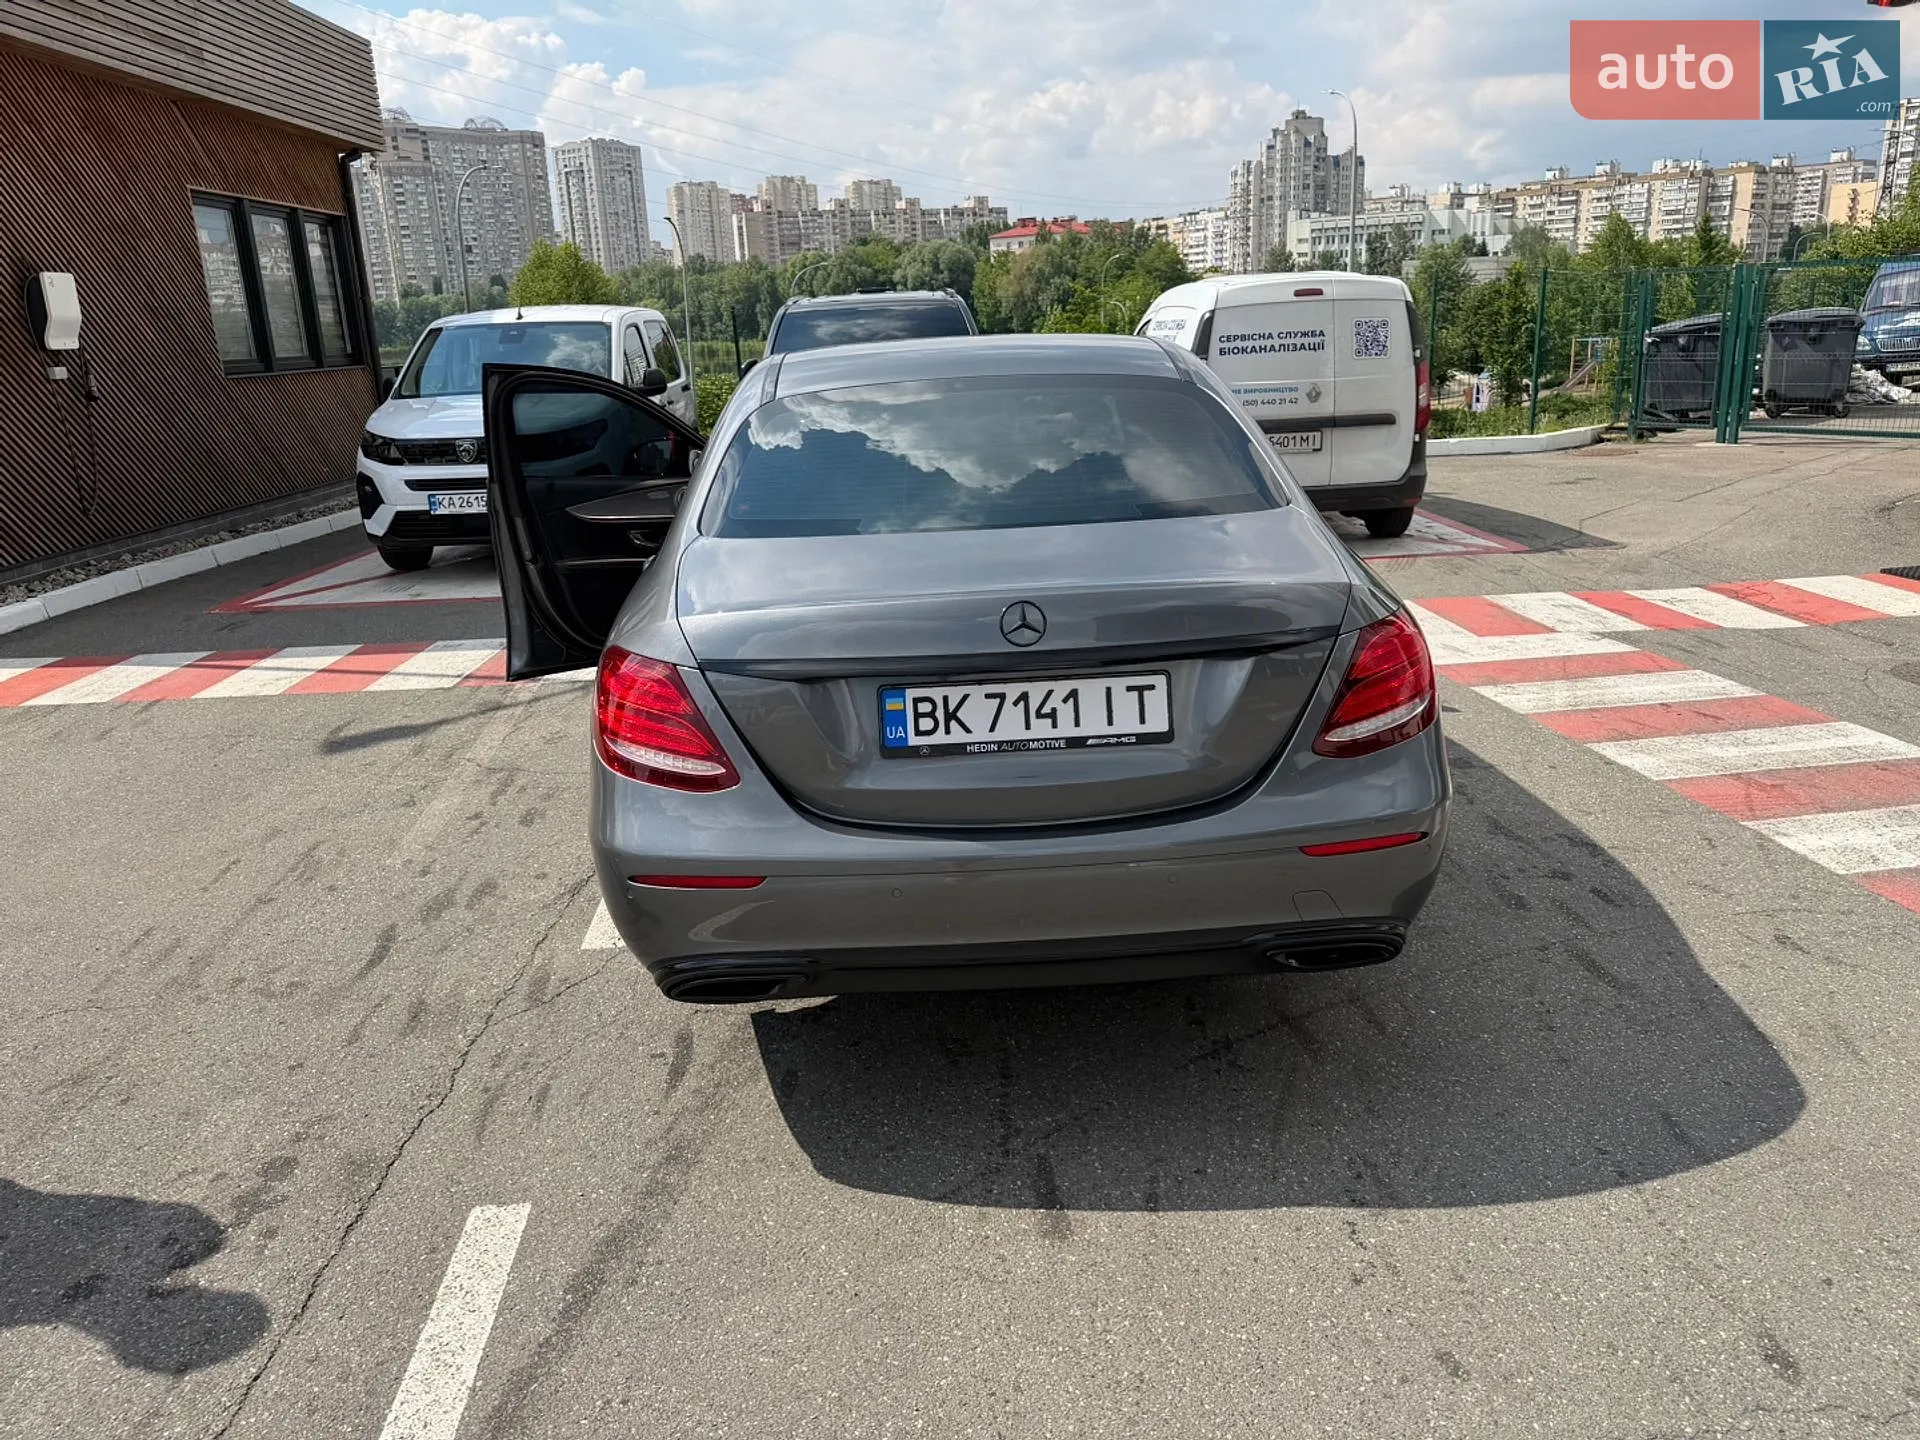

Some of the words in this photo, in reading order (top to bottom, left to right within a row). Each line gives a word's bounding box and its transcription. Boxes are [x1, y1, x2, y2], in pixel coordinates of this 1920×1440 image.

[1219, 332, 1274, 343] СЕРВІСНА
[1277, 330, 1325, 339] СЛУЖБА
[1219, 339, 1325, 356] БІОКАНАЛІЗАЦІЇ
[437, 496, 457, 509] KA
[912, 693, 973, 737] BK
[984, 688, 1081, 733] 7141
[1105, 684, 1156, 726] IT
[886, 726, 906, 739] UA
[966, 743, 998, 753] HEDIN
[1001, 739, 1067, 751] AUTOMOTIVE
